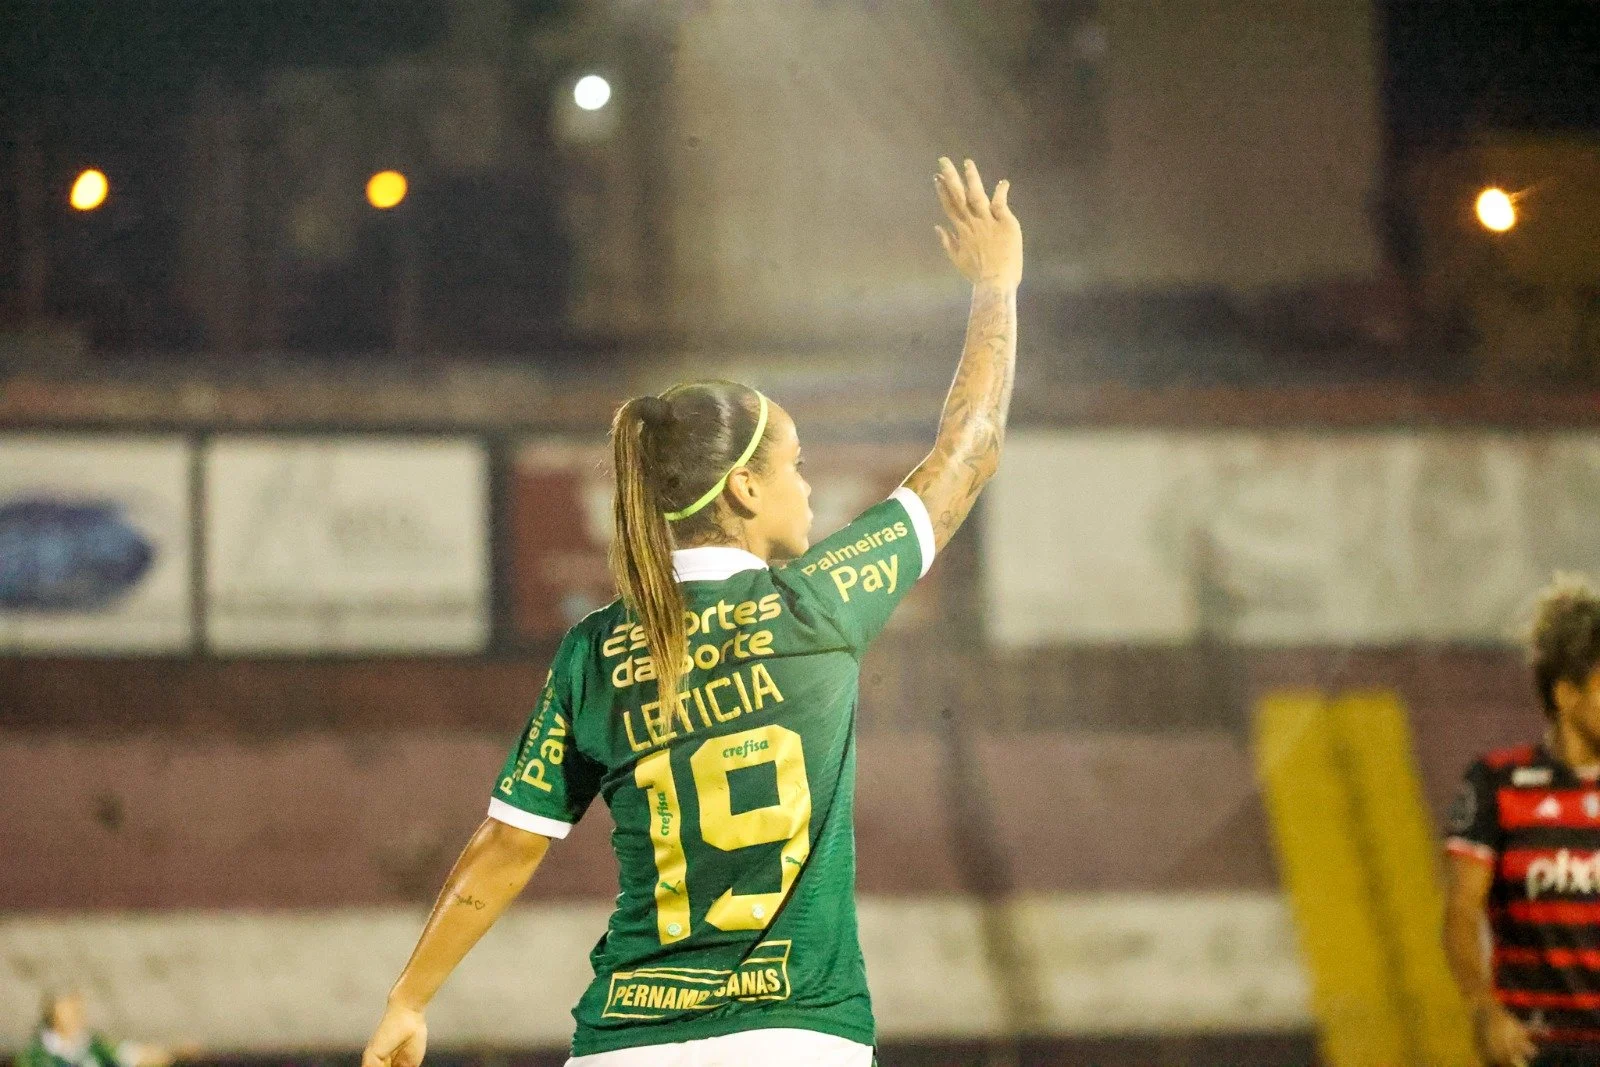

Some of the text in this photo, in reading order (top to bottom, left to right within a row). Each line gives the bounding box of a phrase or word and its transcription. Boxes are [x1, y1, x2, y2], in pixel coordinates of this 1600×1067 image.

[801, 521, 908, 576] Palmeiras
[830, 554, 898, 603] Pay
[602, 593, 782, 658] Esortes
[612, 655, 658, 688] da
[623, 662, 785, 752] LETICIA
[722, 739, 769, 759] crefisa
[634, 724, 812, 946] 19
[656, 791, 674, 836] crefisa
